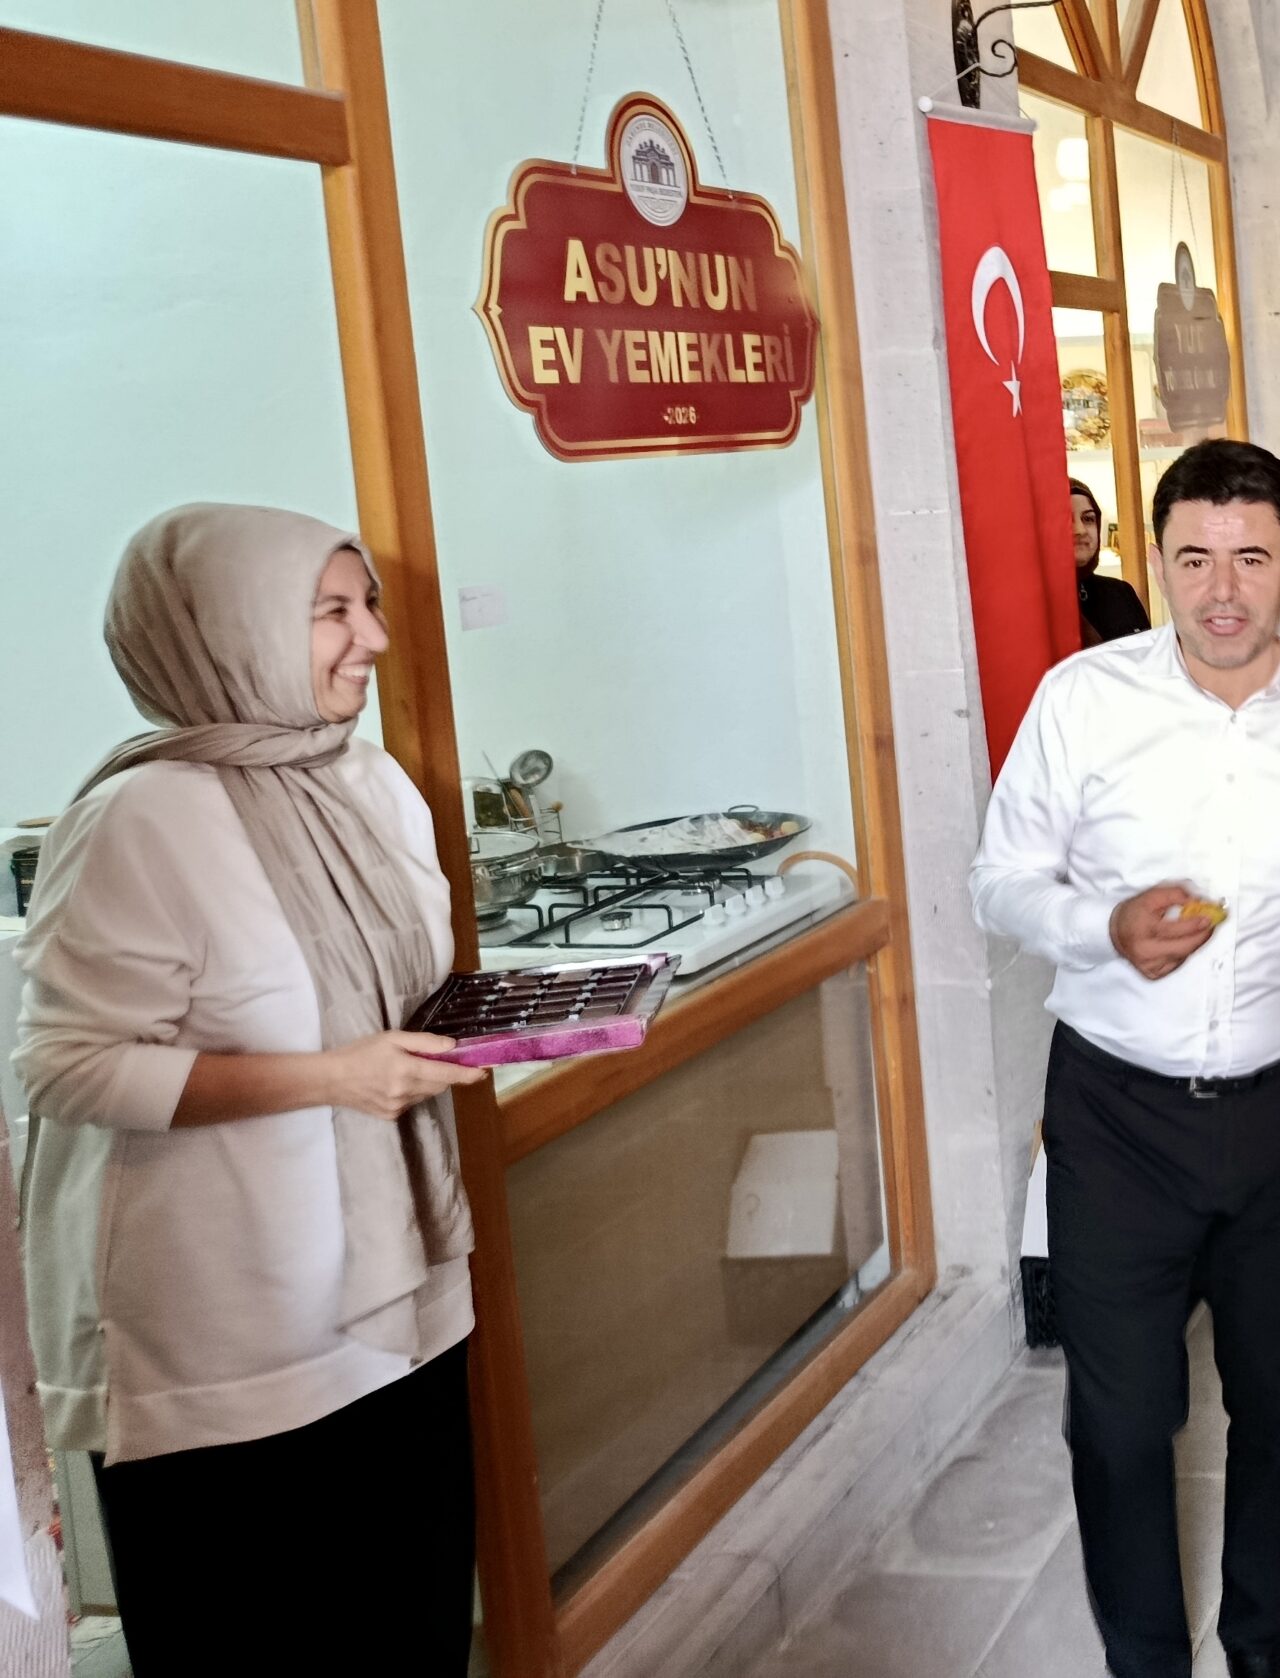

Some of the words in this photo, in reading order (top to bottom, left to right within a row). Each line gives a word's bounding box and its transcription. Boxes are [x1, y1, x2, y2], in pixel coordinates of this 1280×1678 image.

[564, 239, 757, 312] ASU'NUN
[528, 326, 584, 384] EV
[596, 323, 796, 384] YEMEKLERİ
